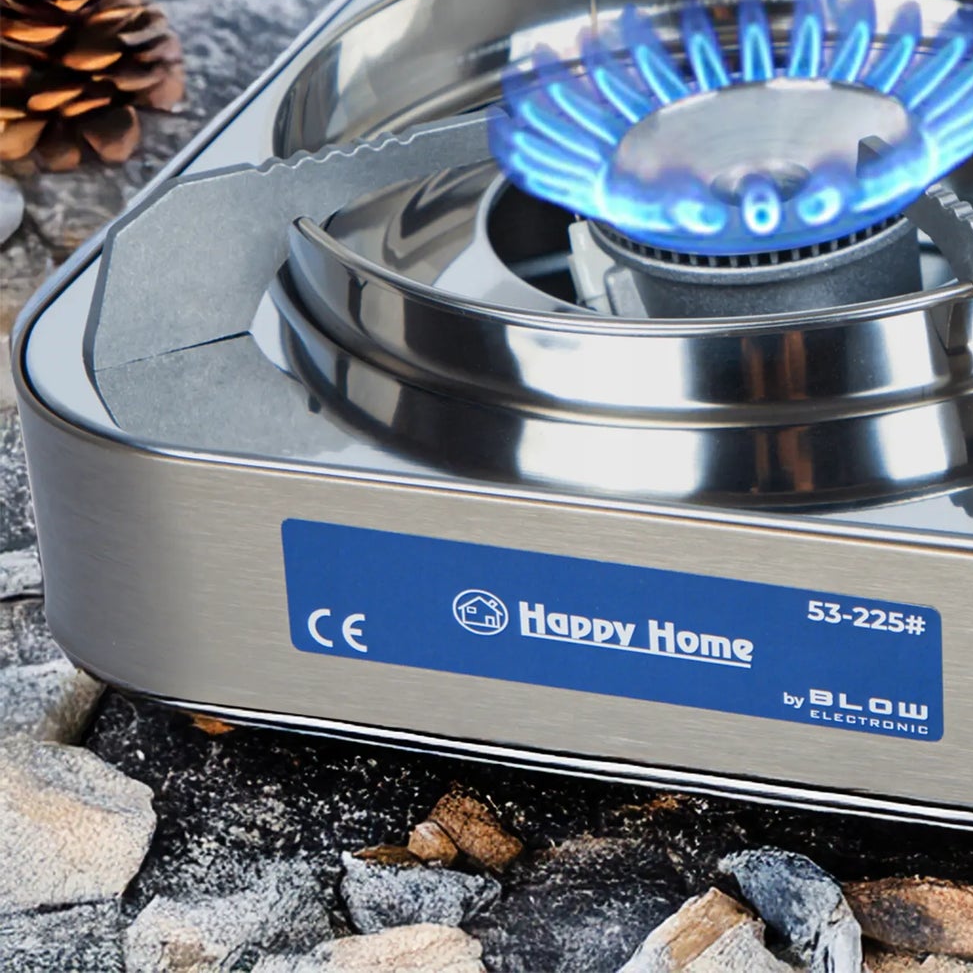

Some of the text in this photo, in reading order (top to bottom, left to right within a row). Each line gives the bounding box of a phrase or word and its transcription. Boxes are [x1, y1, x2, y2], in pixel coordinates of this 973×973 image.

[307, 608, 368, 653] CE
[519, 601, 755, 663] Happy Home
[807, 599, 926, 635] 53-225#
[783, 688, 929, 722] by BLOW
[809, 709, 929, 736] ELECTRONIC
